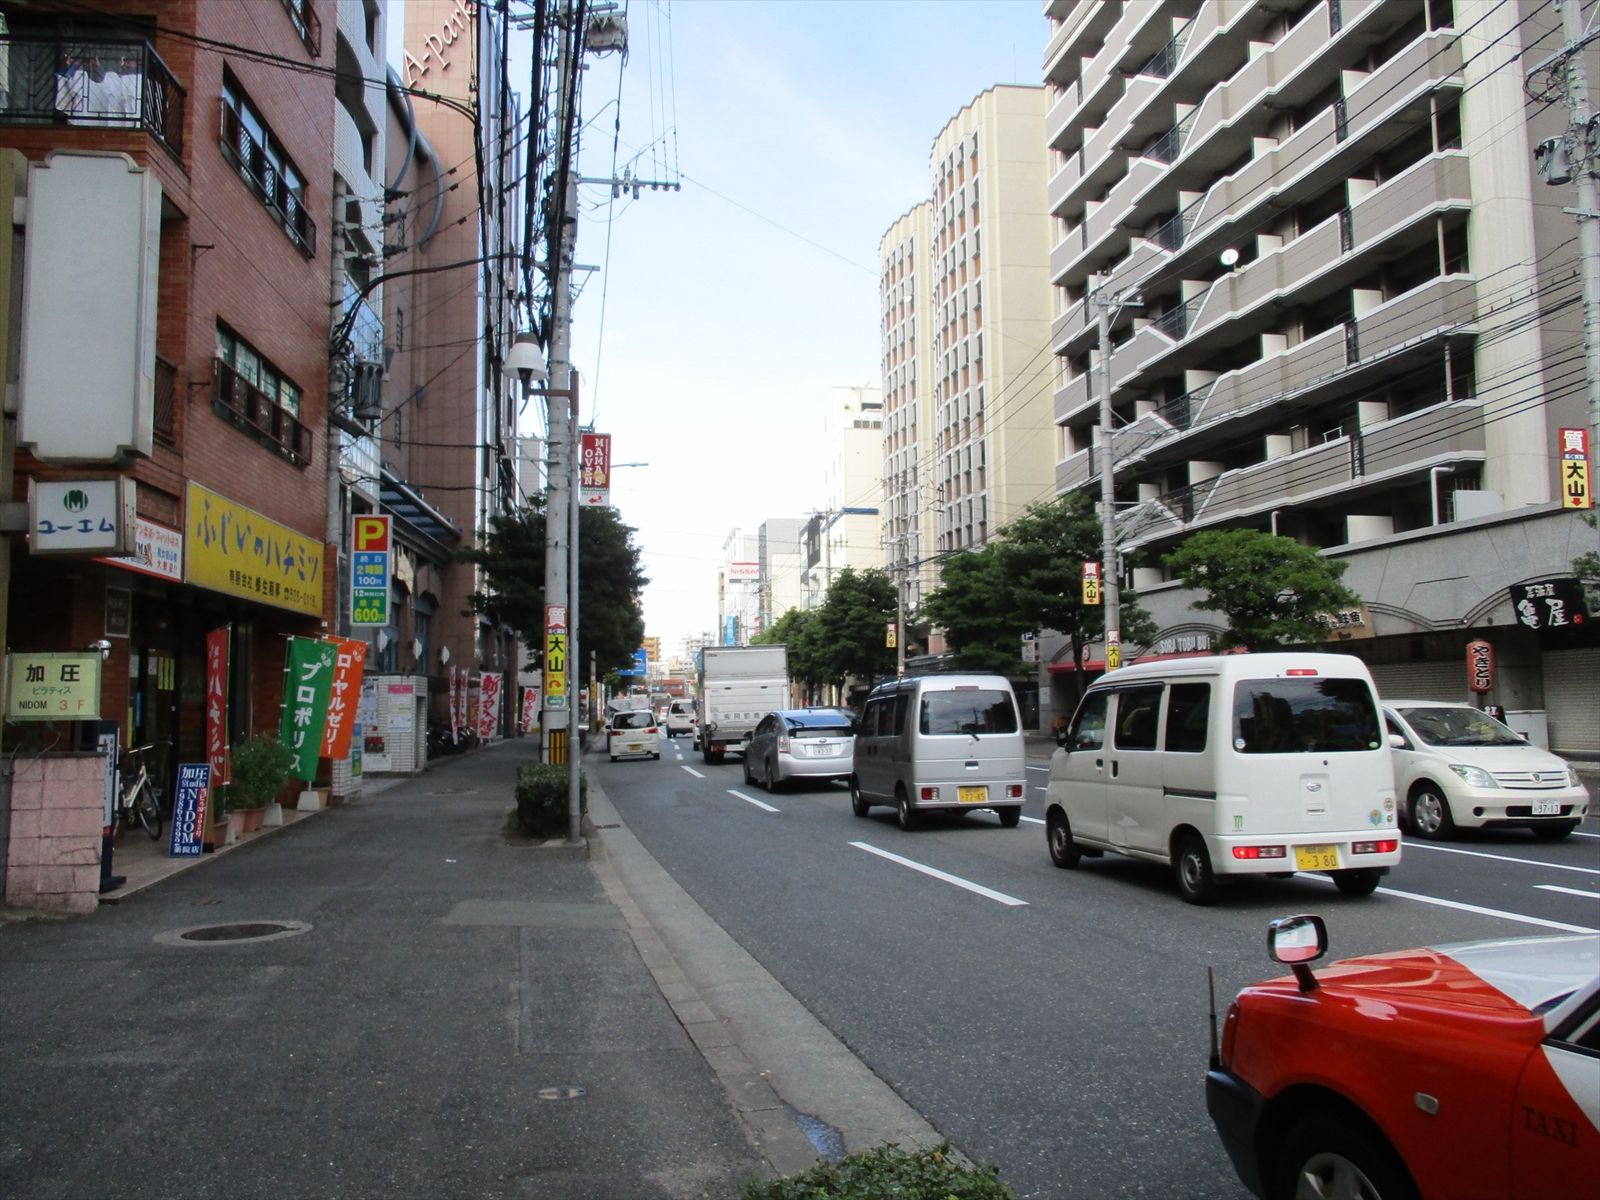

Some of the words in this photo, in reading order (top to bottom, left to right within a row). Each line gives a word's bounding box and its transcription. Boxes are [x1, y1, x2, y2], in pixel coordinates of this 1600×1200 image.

[1564, 431, 1584, 452] 質
[1567, 462, 1585, 497] 大山
[37, 518, 115, 534] ユーエム
[196, 498, 318, 583] ふじいのハチミツ
[358, 520, 385, 550] P
[1086, 580, 1097, 598] 大山
[354, 608, 385, 622] 600円
[548, 637, 564, 672] 大山
[1109, 647, 1119, 667] 大山
[1473, 645, 1491, 689] やきとり
[25, 664, 80, 682] 加圧
[19, 701, 47, 709] NIDOM
[289, 662, 322, 773] プロポリス
[326, 653, 352, 755] ローヤルゼリー
[182, 789, 199, 843] NIDOM
[1521, 1104, 1580, 1149] TAXI
